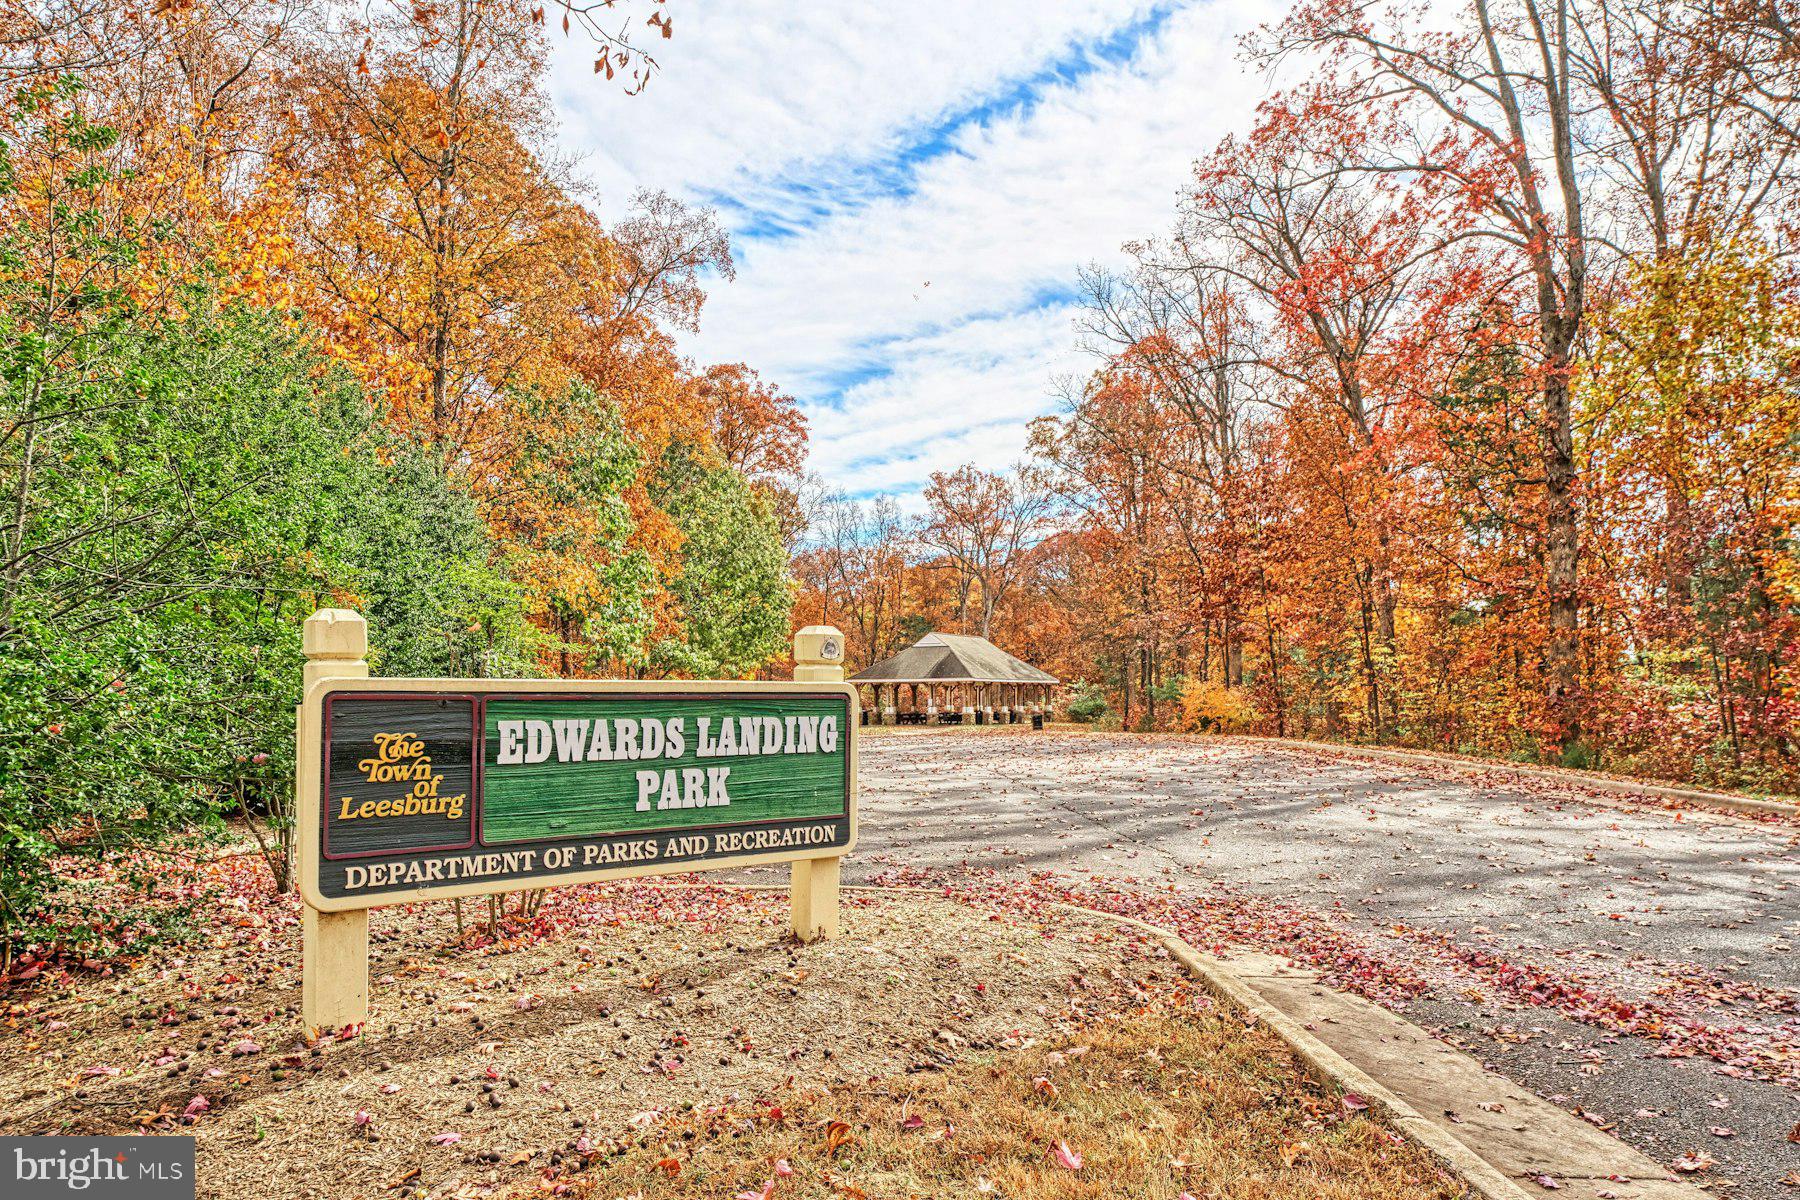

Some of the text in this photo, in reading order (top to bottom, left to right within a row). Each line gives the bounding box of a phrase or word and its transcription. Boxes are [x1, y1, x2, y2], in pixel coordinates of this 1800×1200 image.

[373, 732, 425, 763] The
[497, 715, 838, 765] EDWARDS LANDING
[358, 757, 431, 783] Town
[413, 775, 444, 798] of
[635, 767, 731, 812] PARK
[338, 793, 466, 820] Leesburg
[344, 824, 837, 890] DEPARTMENT OF PARKS AND RECREATION
